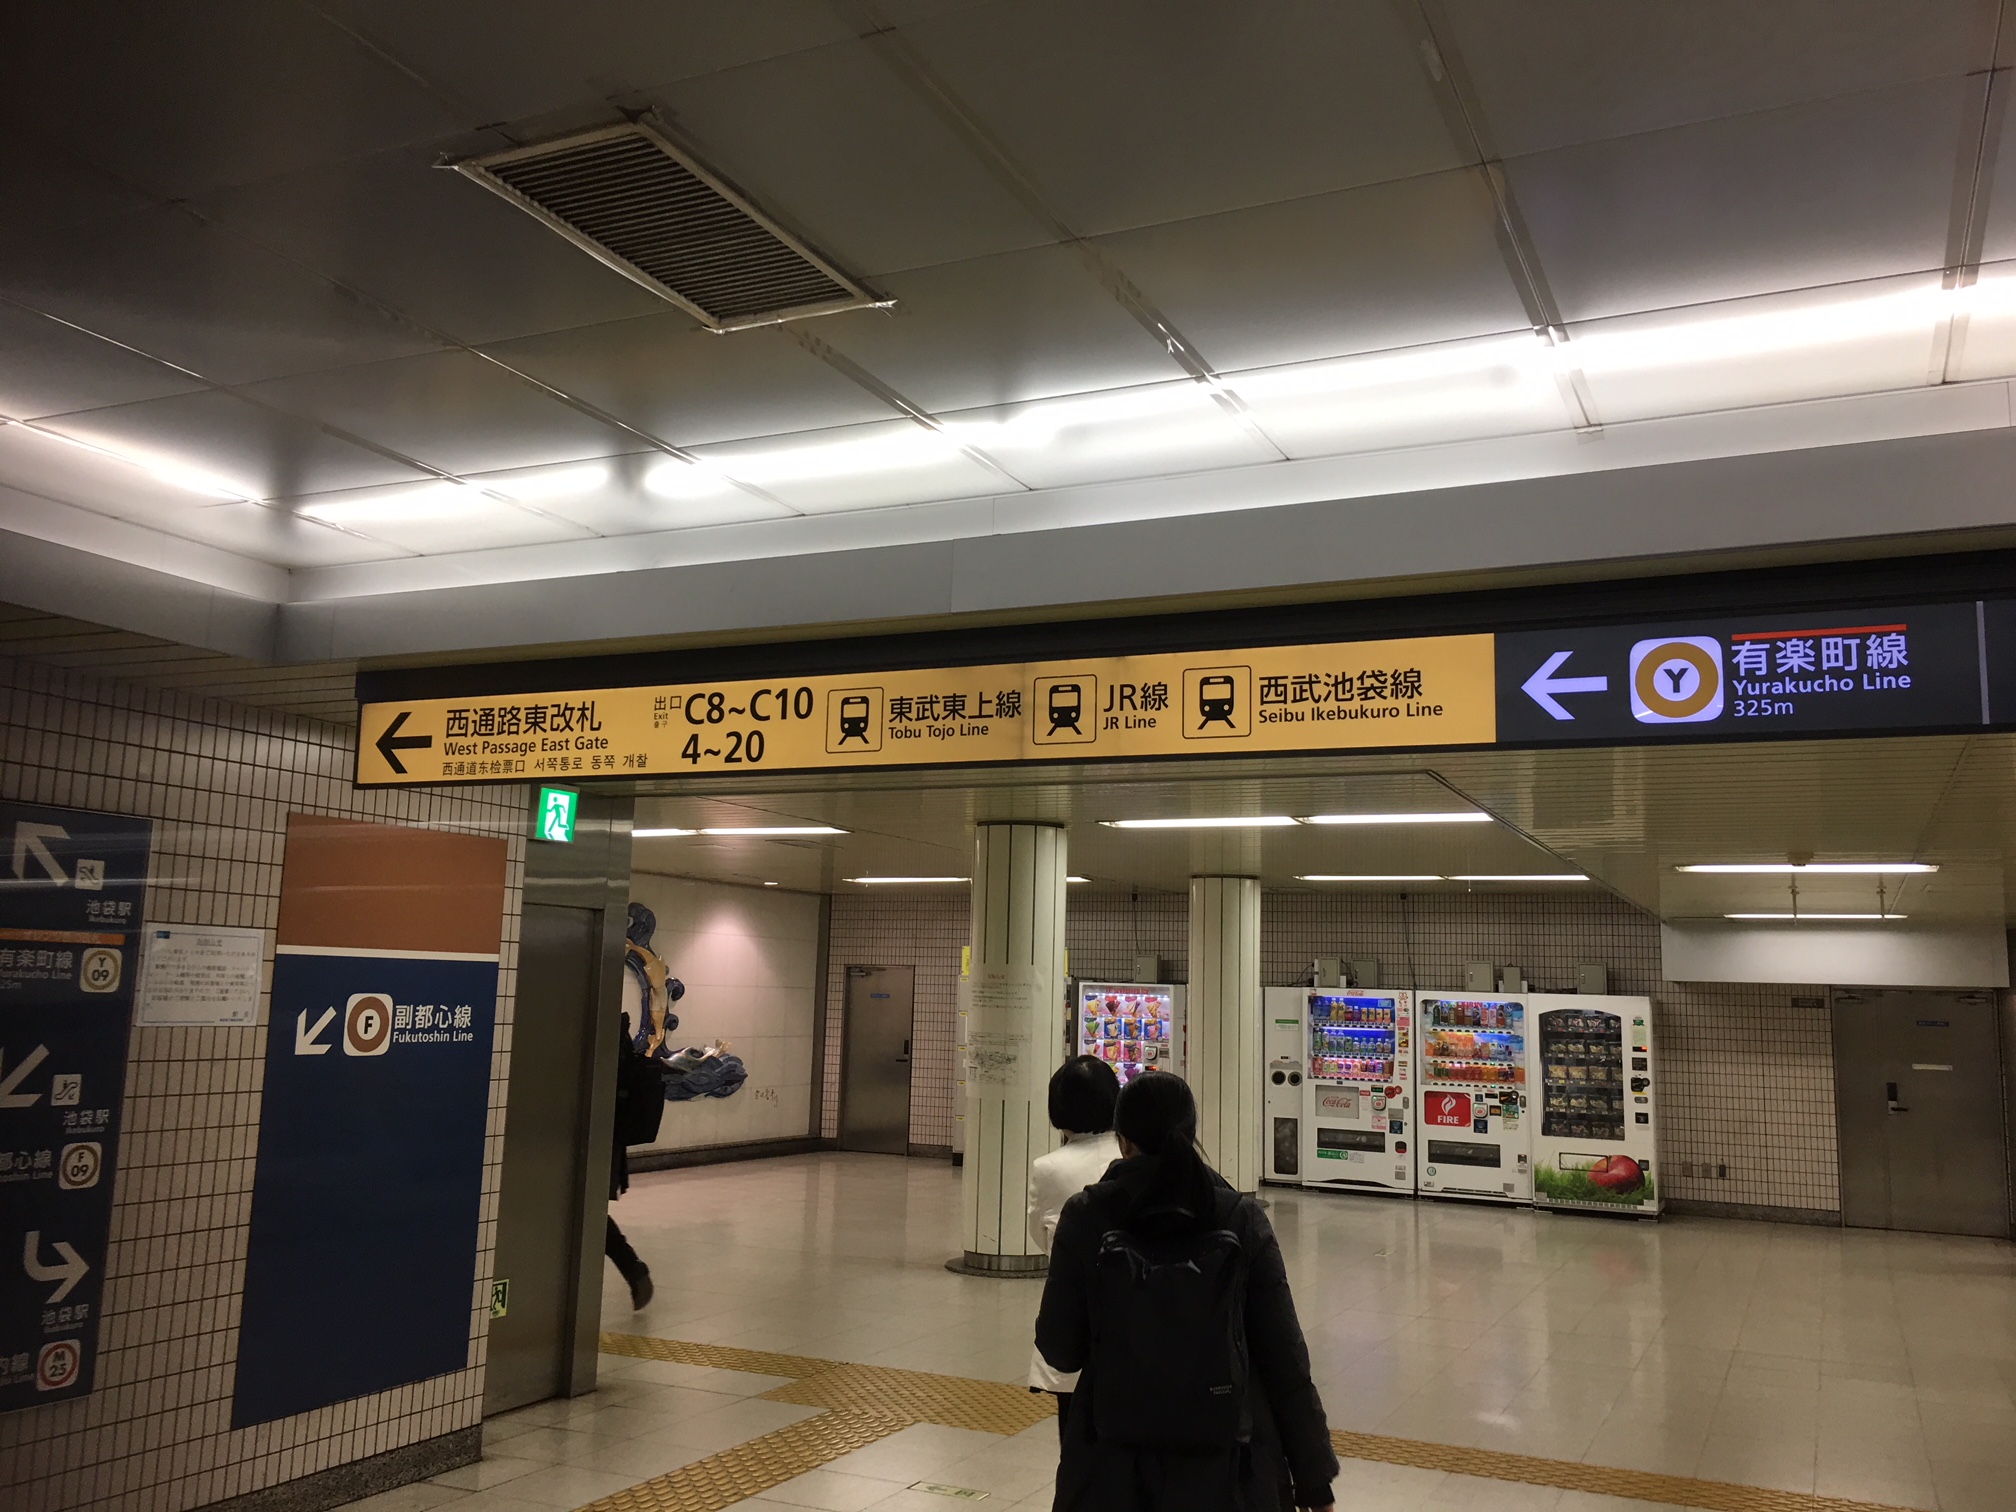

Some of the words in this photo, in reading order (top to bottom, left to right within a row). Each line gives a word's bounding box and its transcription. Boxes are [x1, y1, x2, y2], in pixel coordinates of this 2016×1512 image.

[1731, 634, 1909, 676] 有楽町線
[1258, 668, 1424, 706] 西武池袋線
[1663, 668, 1689, 693] Y
[1732, 675, 1853, 696] Yurakucho
[1863, 673, 1911, 690] Line
[654, 695, 682, 711] 出口
[1102, 682, 1169, 713] JR線
[888, 690, 1023, 724] 東武東上線
[1258, 707, 1304, 723] Seibu
[1311, 704, 1400, 721] Ikebukuro
[1407, 701, 1443, 717] Line
[1733, 699, 1794, 717] 325m
[445, 700, 603, 739] 西通路東改札
[653, 712, 669, 721] Exit
[1102, 716, 1120, 731] JR
[1125, 714, 1157, 730] Line
[888, 725, 921, 740] Tobu
[926, 723, 955, 741] Tojo
[960, 722, 989, 737] Line
[444, 742, 478, 757] West
[482, 740, 537, 758] Passage
[541, 737, 571, 753] East
[574, 735, 609, 751] Gate
[442, 760, 526, 776] 西通道东检票口
[533, 757, 583, 772] 서쪽통로
[591, 754, 616, 770] 동쪽
[622, 752, 649, 769] 개찰
[85, 899, 132, 916] 池袋駅
[0, 948, 73, 969] 有楽町線
[98, 957, 106, 968] Y
[92, 969, 109, 982] 09
[363, 1016, 374, 1035] F
[395, 1005, 472, 1029] 副都心線
[393, 1030, 450, 1044] Fukutoshin
[453, 1030, 473, 1042] Line
[63, 1109, 109, 1126] 池袋駅
[1437, 1115, 1460, 1125] FIRE
[78, 1152, 85, 1163] F
[71, 1164, 89, 1178] 09
[53, 1350, 65, 1363] M
[49, 1363, 66, 1378] 25
